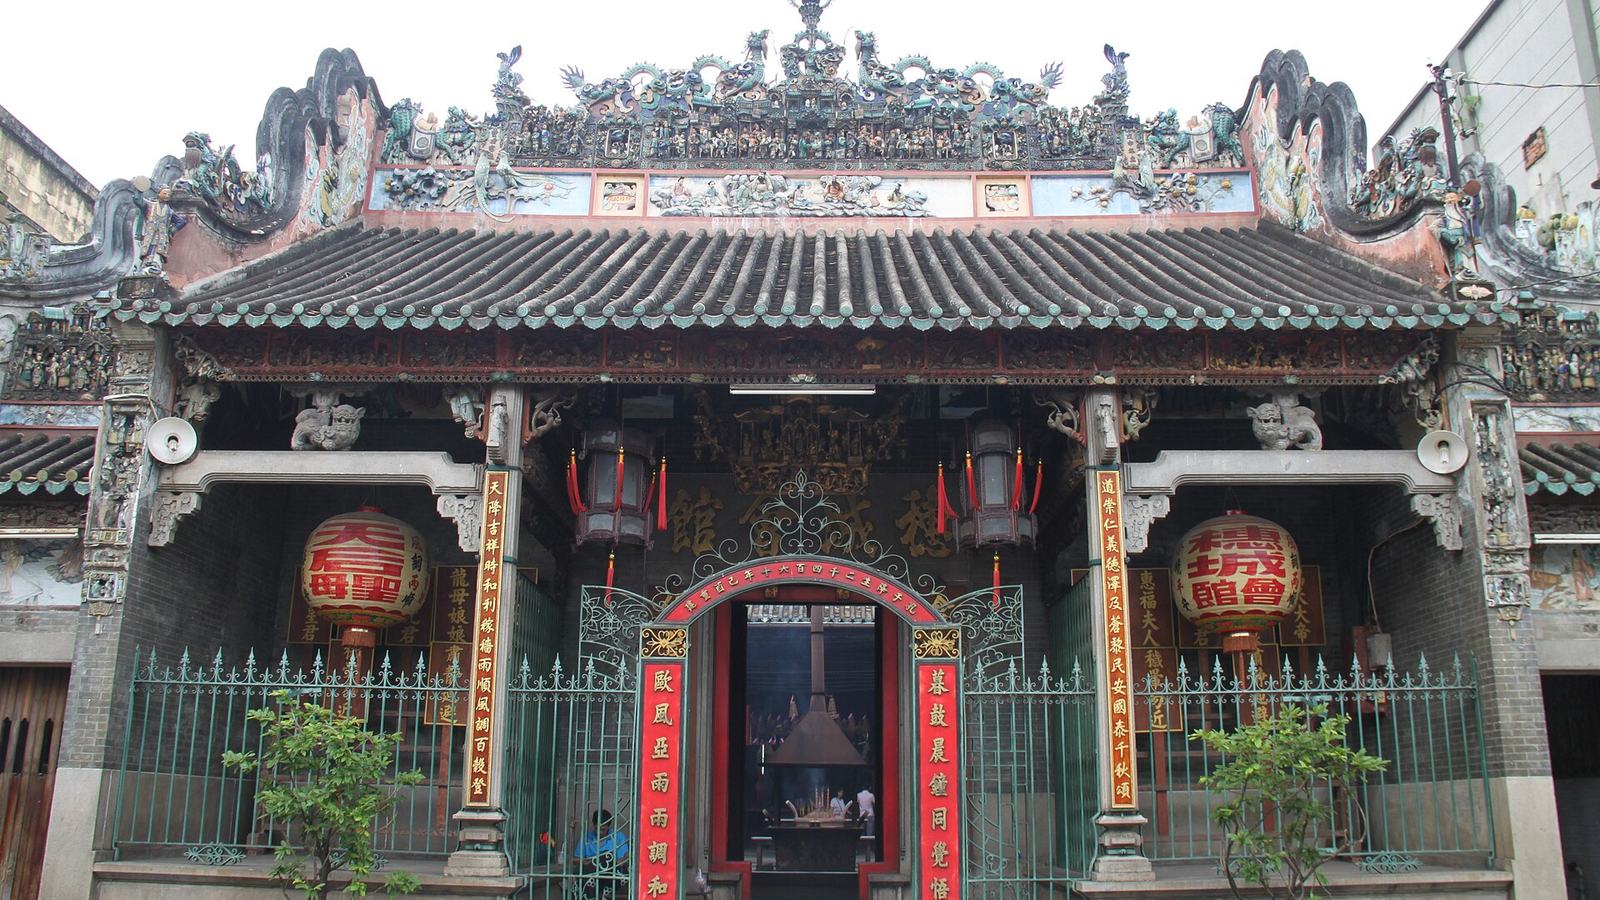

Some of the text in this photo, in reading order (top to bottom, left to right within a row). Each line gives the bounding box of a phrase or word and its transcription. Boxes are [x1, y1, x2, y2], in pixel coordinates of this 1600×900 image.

[447, 567, 471, 643] 龍母娘娘
[1139, 570, 1161, 646] 惠福夫人
[927, 668, 951, 899] 暮鼓晨鐘同覺悟
